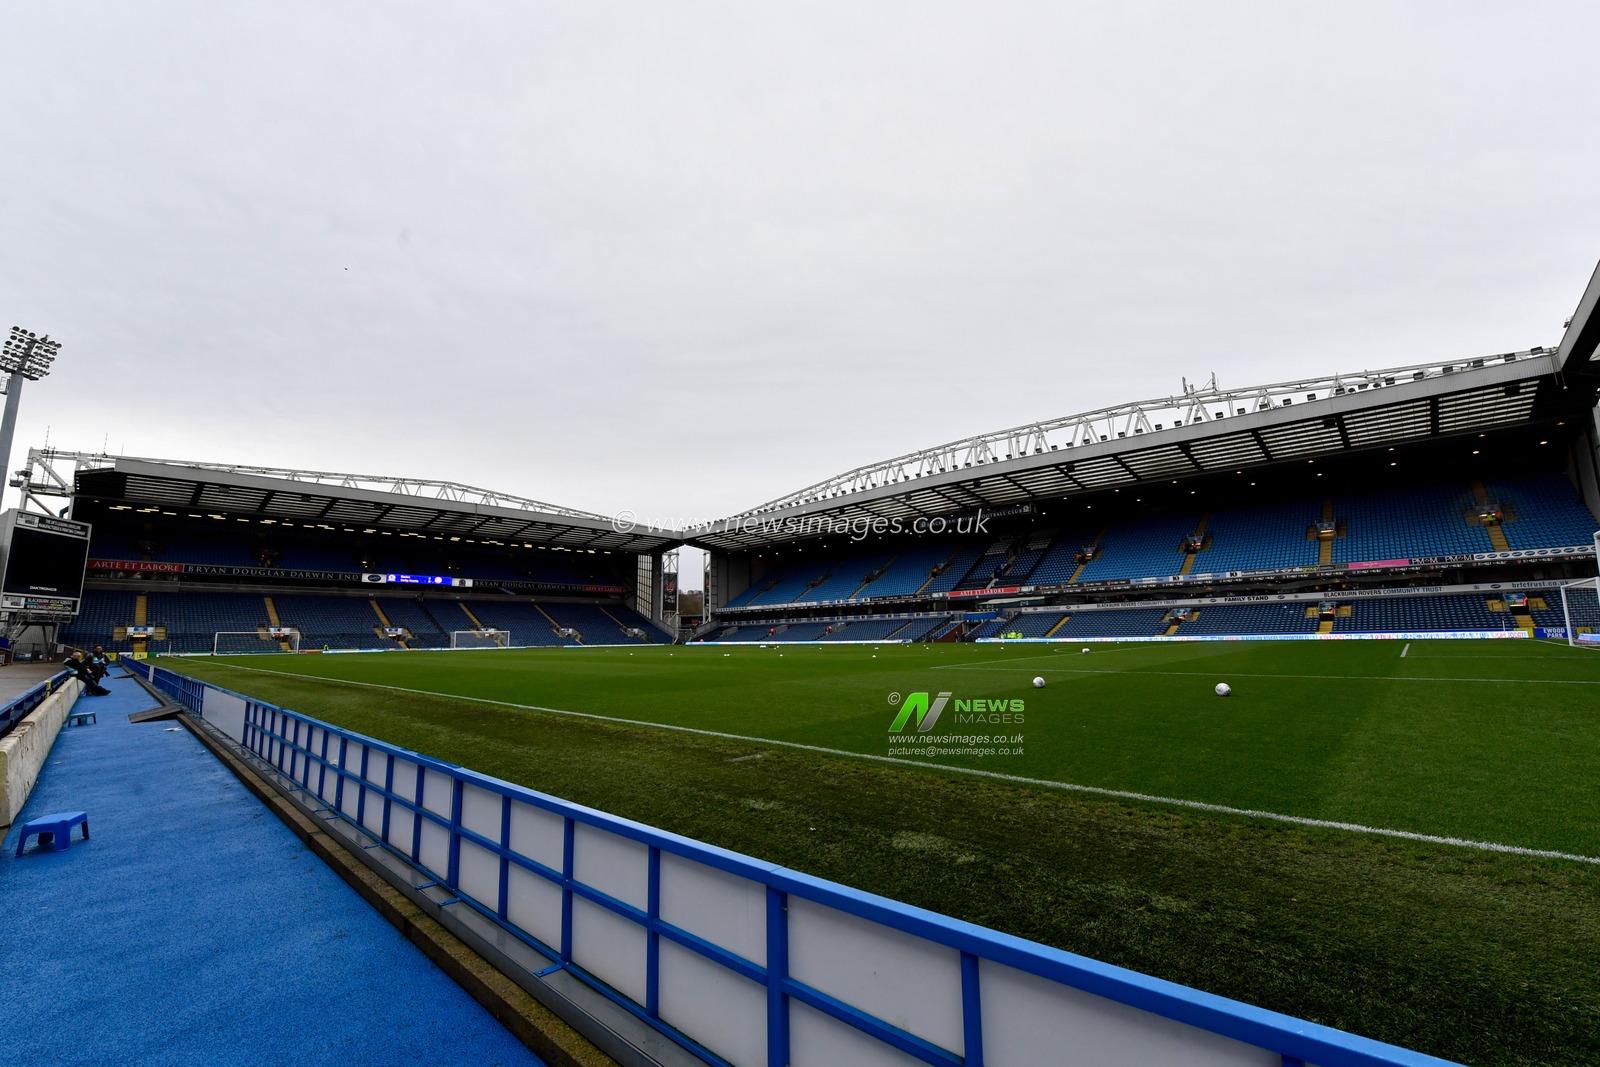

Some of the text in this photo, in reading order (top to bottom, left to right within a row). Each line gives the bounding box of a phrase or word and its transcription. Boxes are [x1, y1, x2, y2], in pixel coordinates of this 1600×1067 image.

[93, 560, 179, 572] ARTE ET LABORE
[188, 565, 227, 574] BRYAN
[232, 568, 285, 577] DOUGLAS
[290, 571, 334, 579] DARWEN
